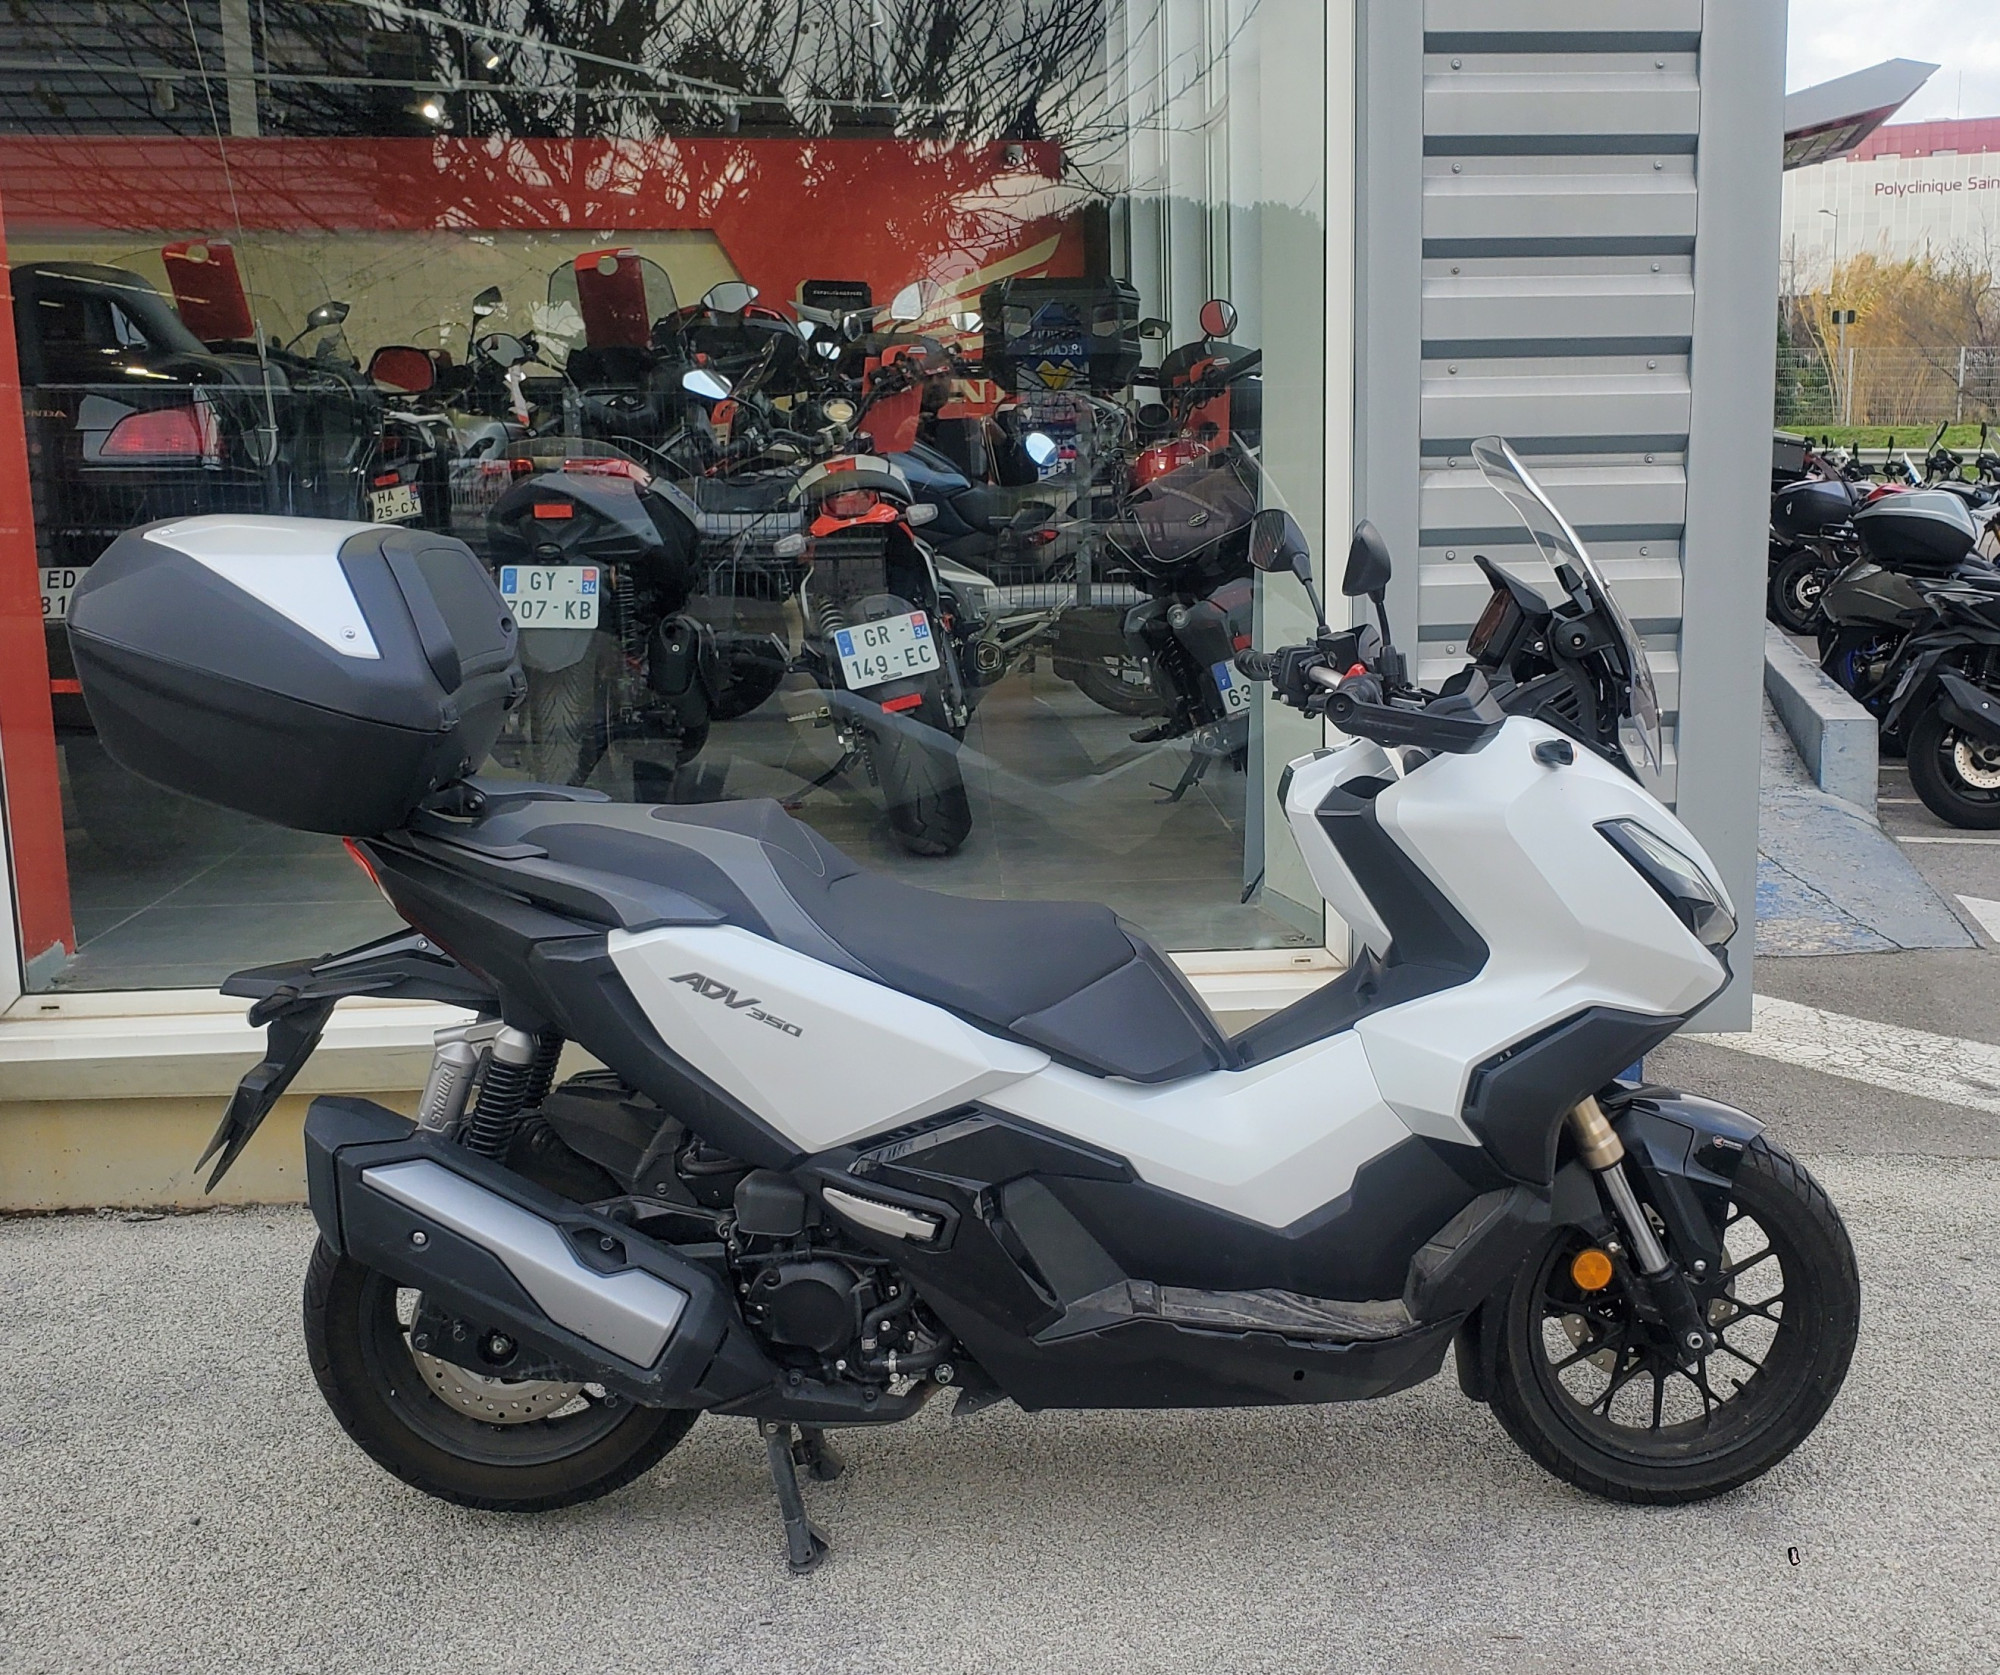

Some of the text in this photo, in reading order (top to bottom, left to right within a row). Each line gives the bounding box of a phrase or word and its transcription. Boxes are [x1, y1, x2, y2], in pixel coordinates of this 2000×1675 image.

[1874, 178, 1963, 198] Polyclinique
[377, 490, 395, 504] HA
[376, 500, 418, 520] 25-CX
[46, 569, 76, 589] ED
[530, 571, 556, 591] GY
[582, 581, 596, 594] 34
[863, 625, 891, 647] GR
[914, 625, 928, 638] 34
[851, 644, 932, 680] 149-EC
[668, 972, 804, 1038] ADV 350
[430, 1067, 456, 1124] SHOWA
